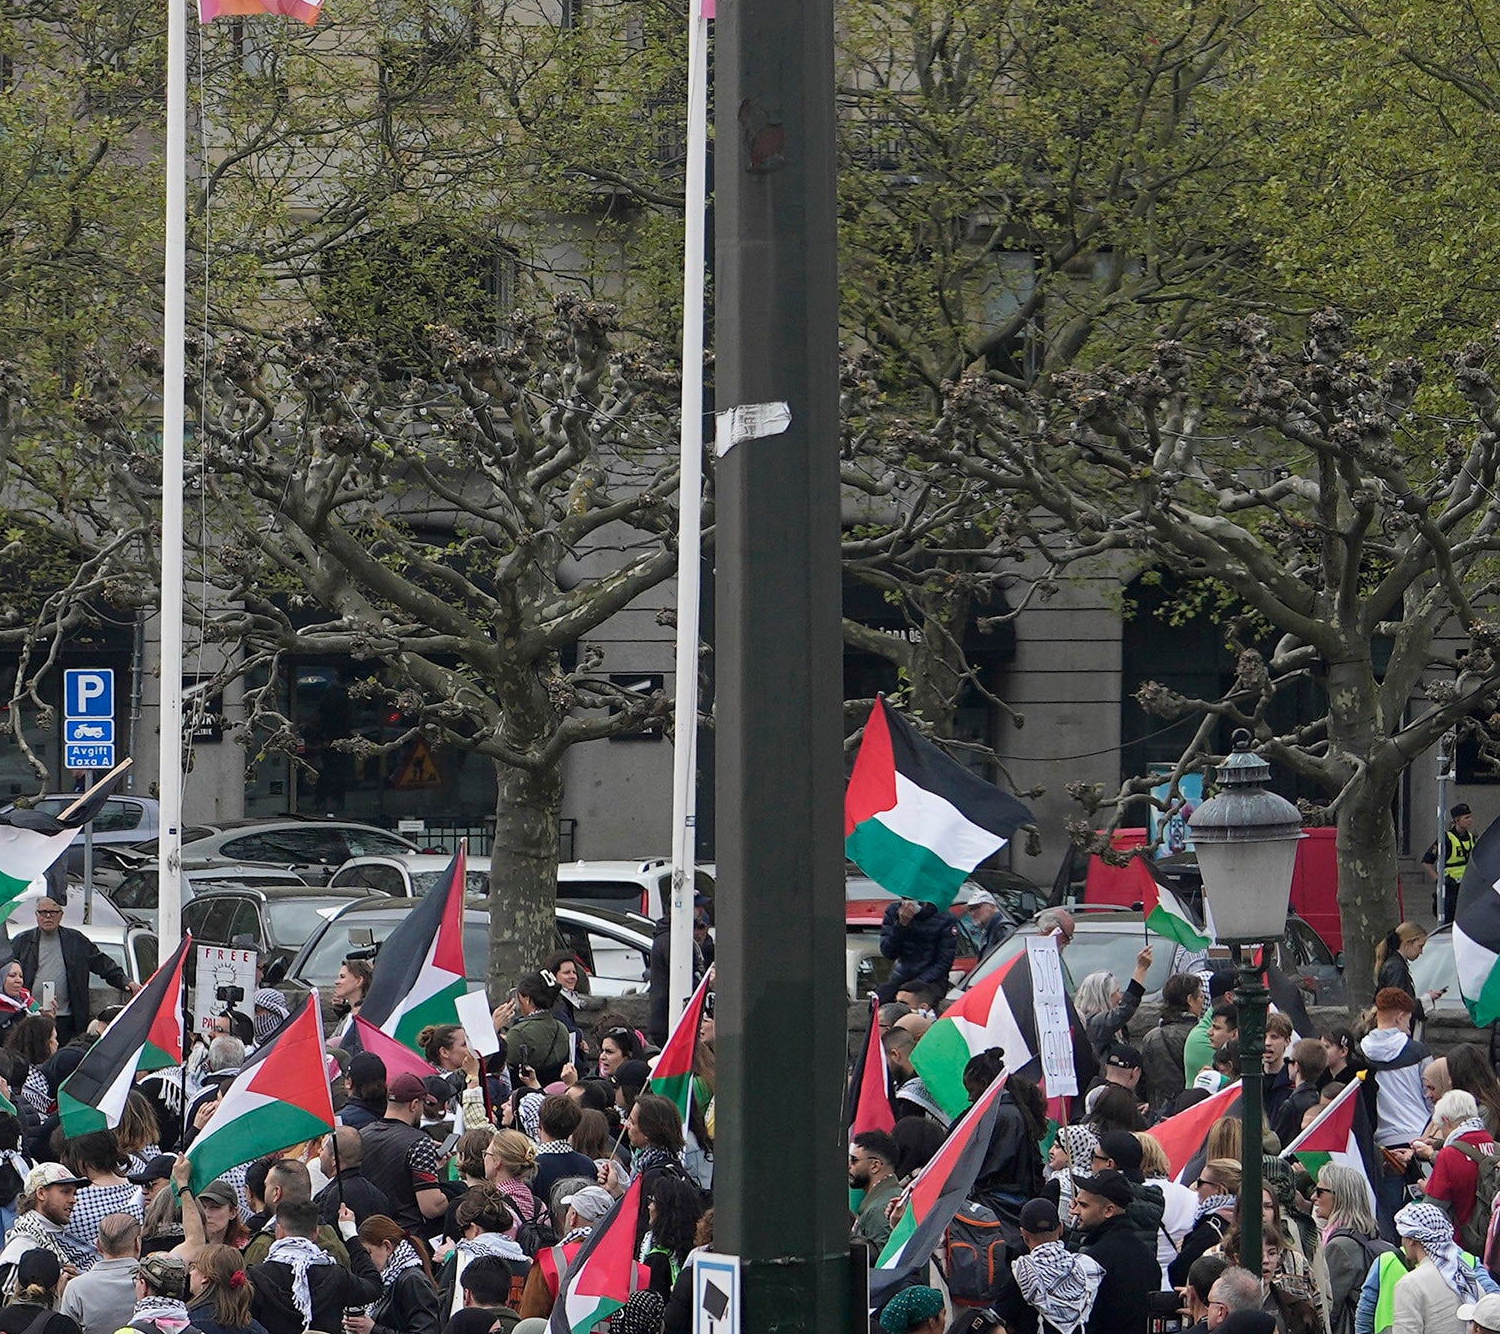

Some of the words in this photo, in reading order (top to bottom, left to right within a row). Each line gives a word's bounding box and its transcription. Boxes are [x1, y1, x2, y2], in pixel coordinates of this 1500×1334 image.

[79, 675, 105, 713] P
[72, 747, 109, 758] Avgift
[70, 757, 98, 767] Taxa
[100, 757, 110, 767] A
[204, 948, 249, 964] FREE
